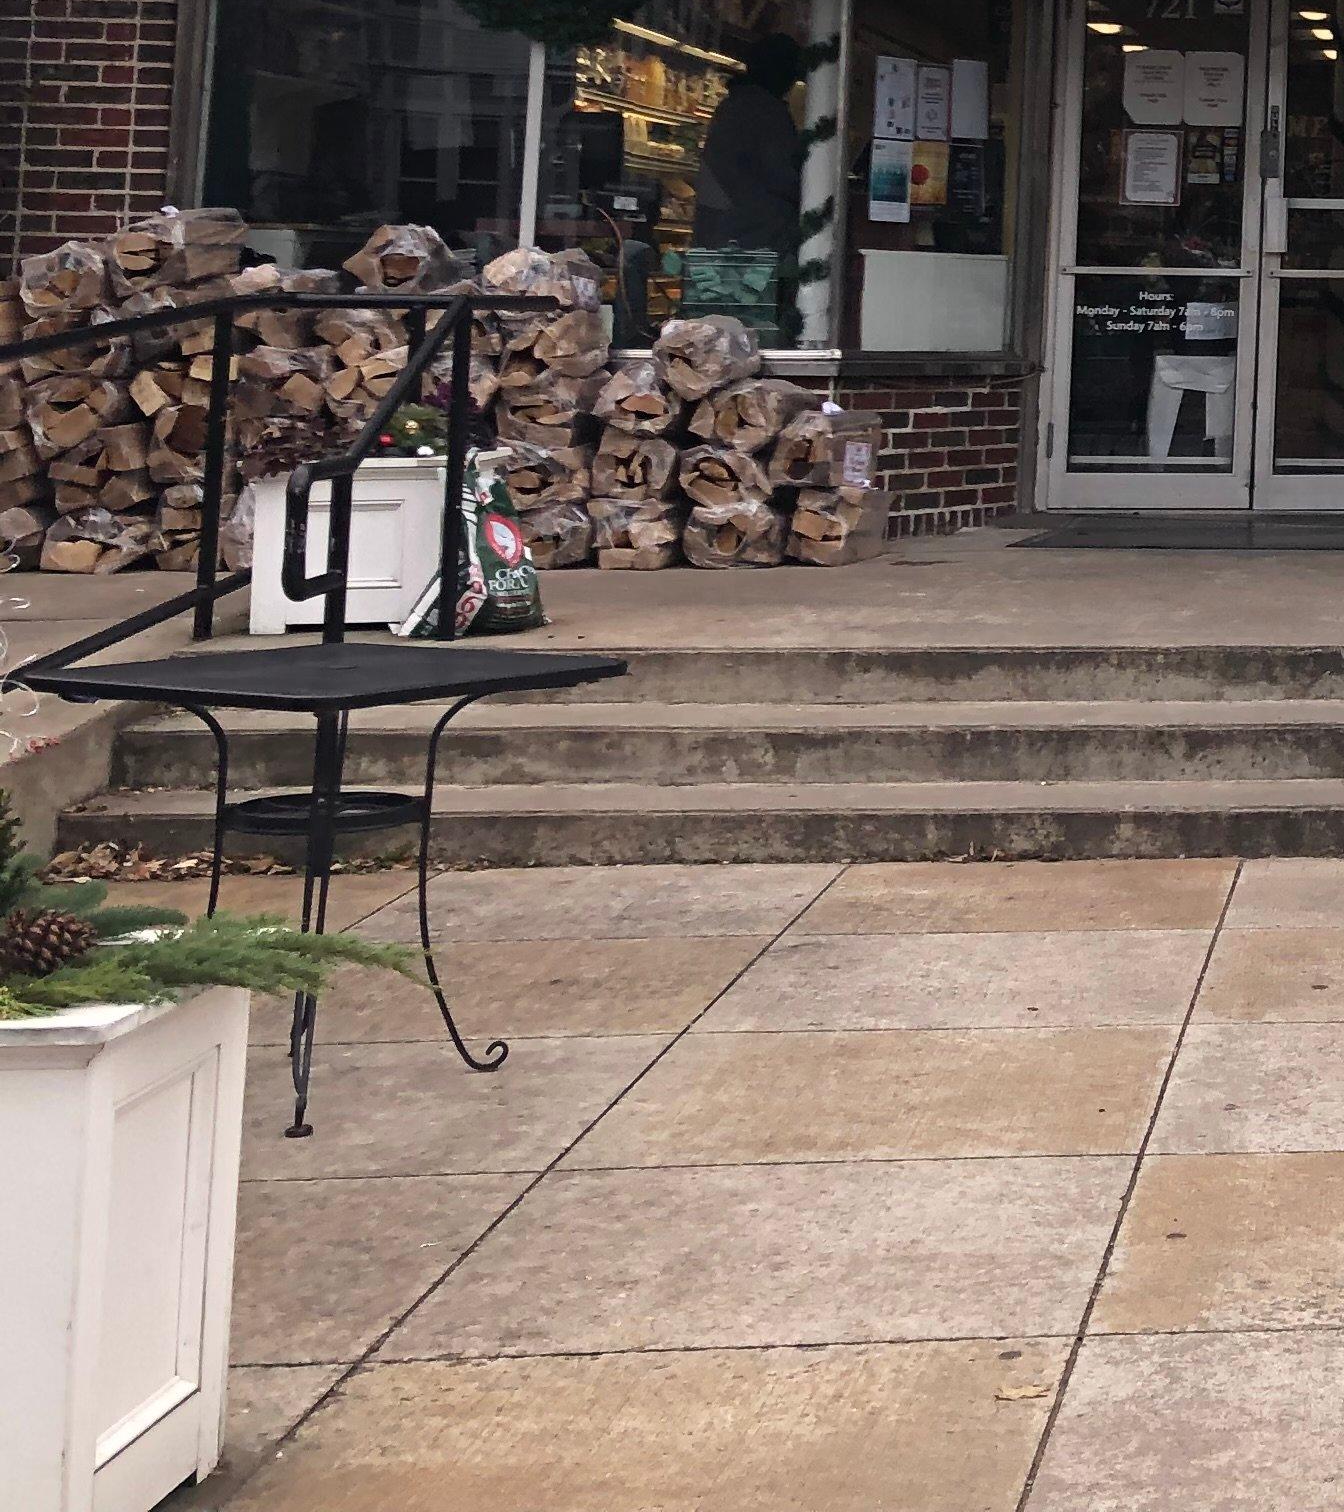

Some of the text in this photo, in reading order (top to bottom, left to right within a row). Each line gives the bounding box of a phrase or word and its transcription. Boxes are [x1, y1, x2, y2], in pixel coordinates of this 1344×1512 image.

[1076, 304, 1121, 318] Monday
[1128, 305, 1175, 319] Saturday
[1106, 320, 1145, 333] Sunday
